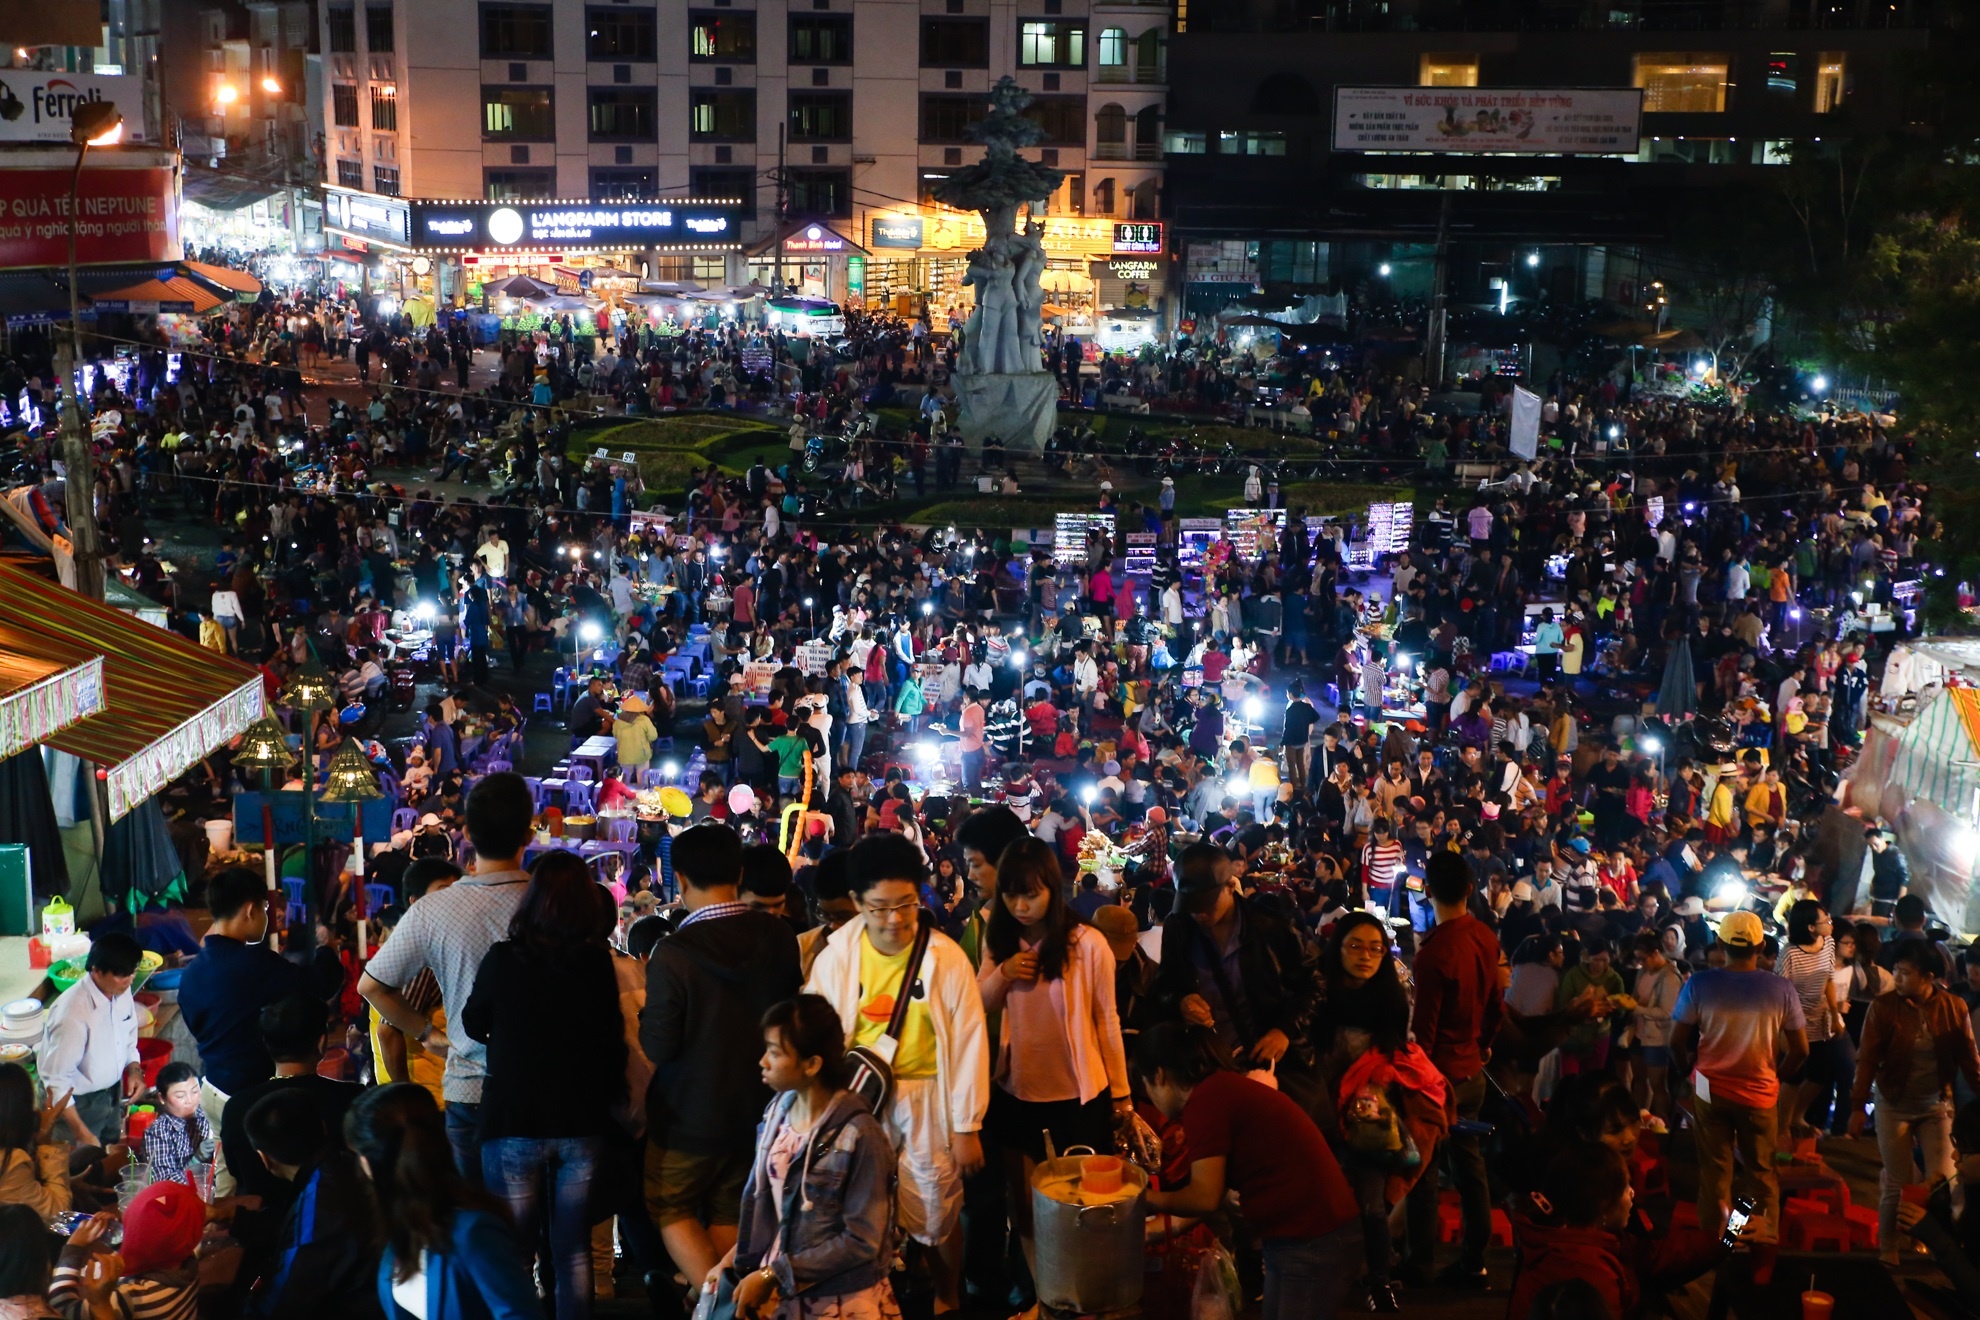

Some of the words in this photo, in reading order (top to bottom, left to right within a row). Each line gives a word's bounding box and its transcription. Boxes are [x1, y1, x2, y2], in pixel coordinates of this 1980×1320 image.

[12, 194, 51, 217] QUÀ
[86, 197, 156, 215] NEPTUNE
[531, 212, 620, 227] L'ANGFARM
[621, 212, 672, 227] STORE
[75, 220, 104, 237] tặng
[824, 240, 842, 249] Hotel
[1109, 261, 1157, 270] L'ANGFARM
[1117, 270, 1150, 279] COFFEE
